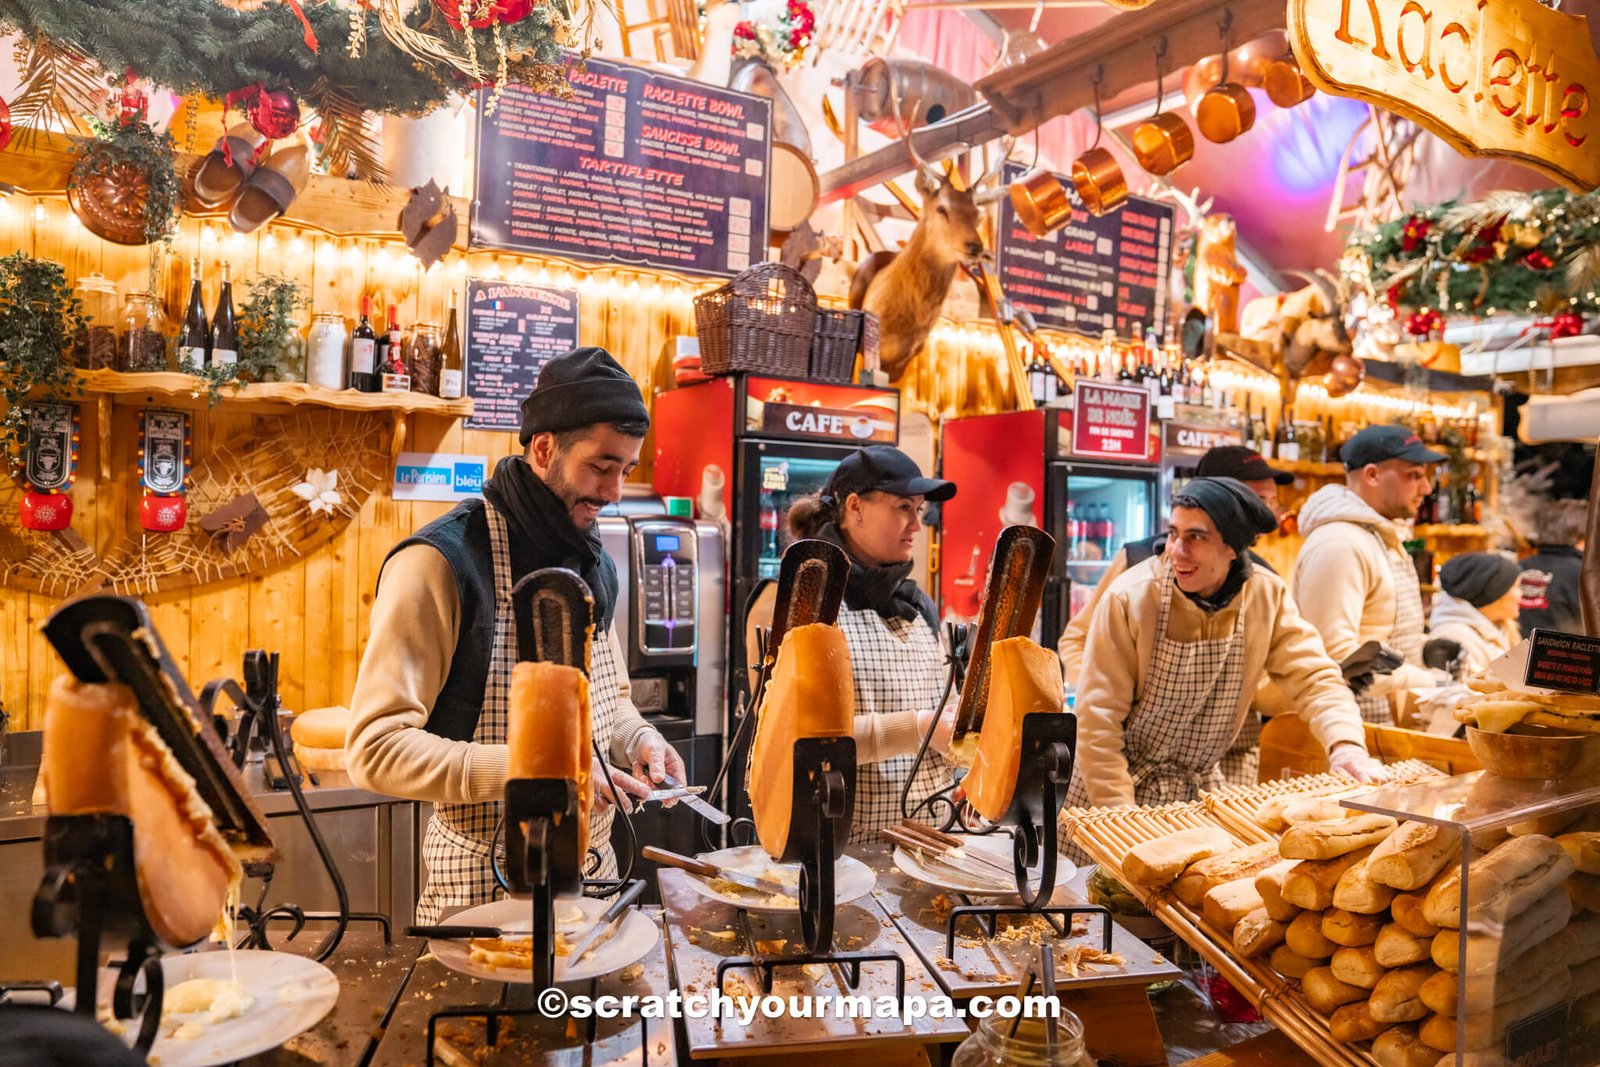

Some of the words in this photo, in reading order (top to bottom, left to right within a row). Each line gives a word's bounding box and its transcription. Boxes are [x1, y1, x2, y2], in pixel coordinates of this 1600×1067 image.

[569, 68, 628, 94] RACLETTE
[643, 83, 707, 111] RACLETTE
[708, 98, 745, 120] BOWL
[641, 124, 703, 149] SAUCISSE
[704, 137, 741, 157] BOWL
[578, 156, 685, 186] TARTIFLETTE
[1084, 388, 1101, 404] LA
[786, 411, 843, 434] CAFE
[1177, 430, 1209, 448] CAFE
[401, 471, 411, 484] Le
[411, 468, 446, 484] Parisien
[455, 475, 481, 487] bleu
[1537, 637, 1571, 649] SANDWICH
